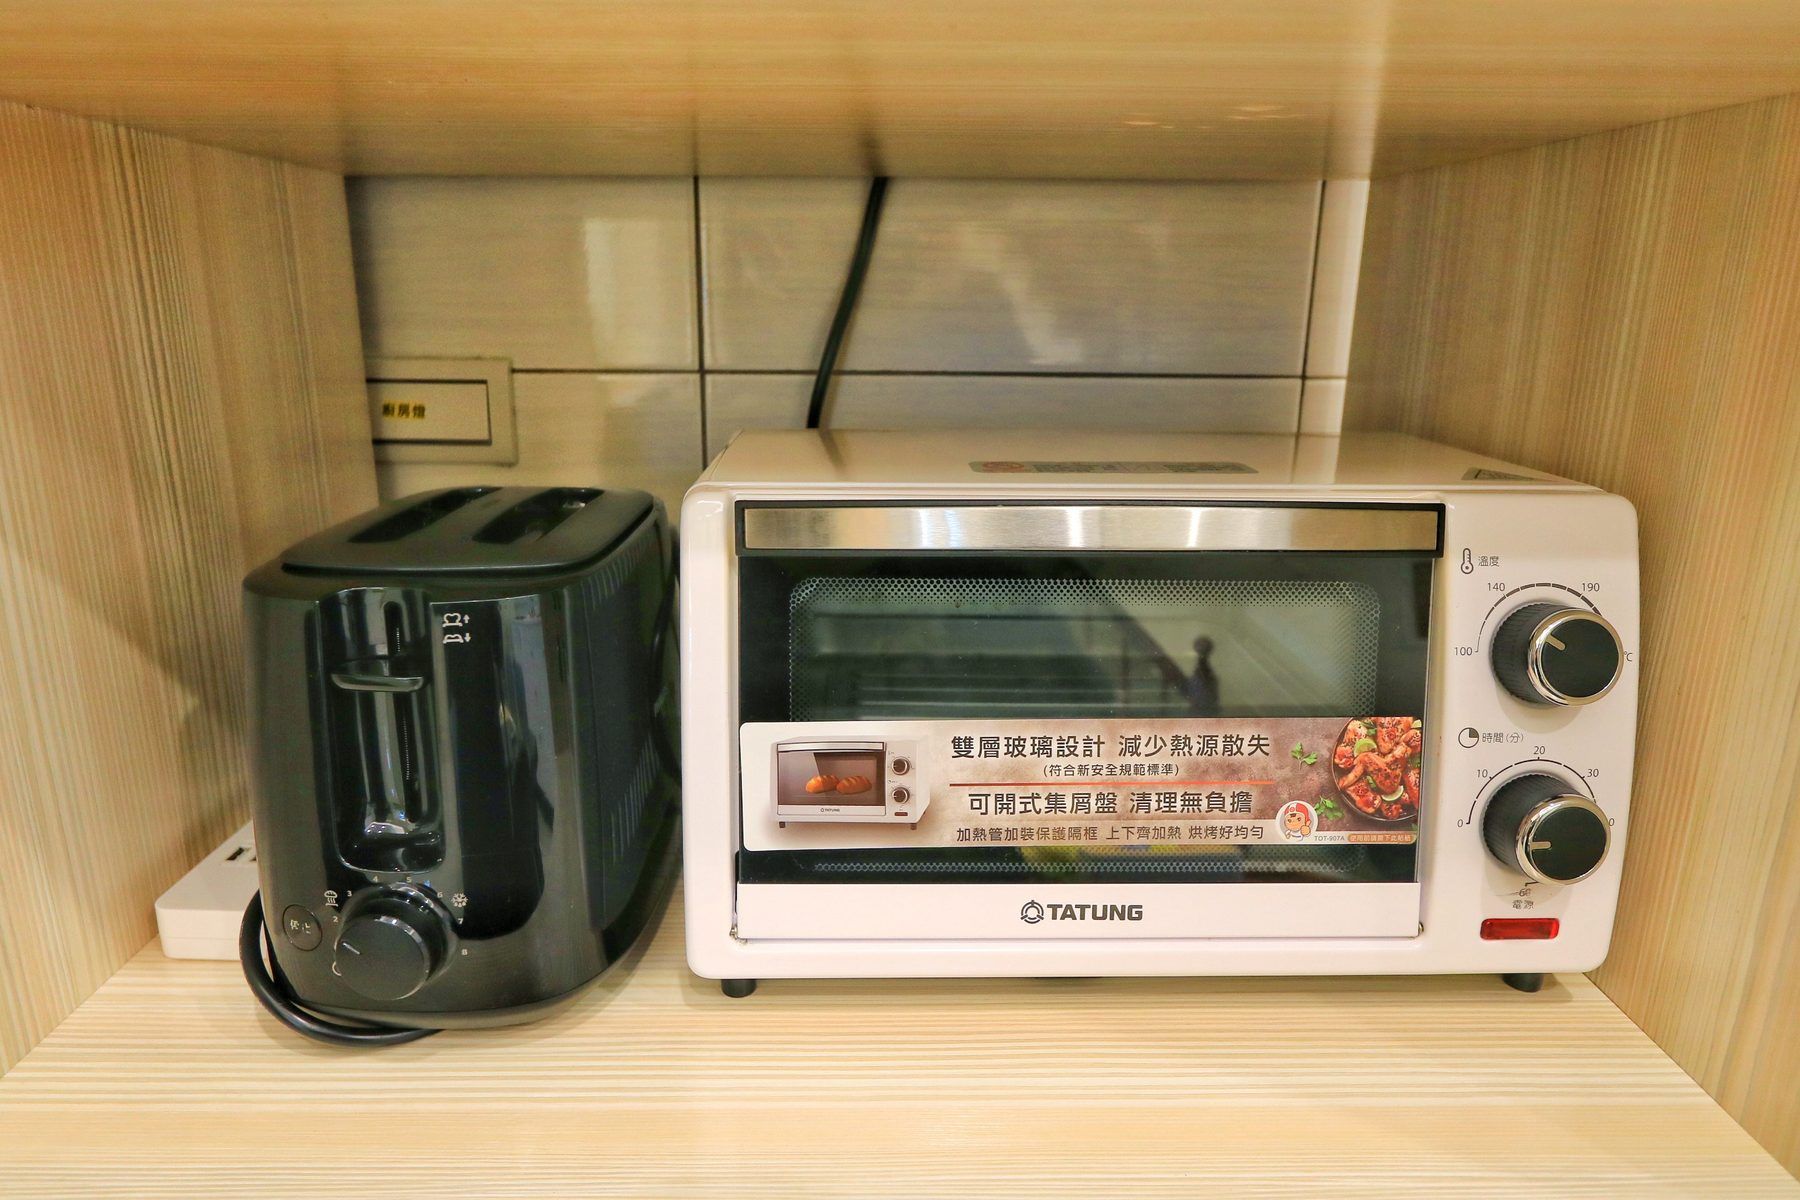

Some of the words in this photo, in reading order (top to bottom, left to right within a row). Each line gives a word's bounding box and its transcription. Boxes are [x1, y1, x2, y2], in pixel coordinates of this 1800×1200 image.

[1478, 555, 1500, 567] 溫度
[1487, 582, 1506, 591] 140
[1582, 582, 1600, 592] 190
[1454, 646, 1473, 656] 100
[951, 735, 1106, 759] 雙層玻璃設計
[1118, 734, 1270, 757] 減少熱源散失
[1533, 745, 1546, 755] 20
[1043, 763, 1180, 778] (符合新安全規範標準)
[1476, 769, 1488, 778] 10
[1587, 768, 1600, 778] 30
[968, 792, 1118, 815] 可開式集屑盤
[1129, 791, 1253, 814] 清理無負擔
[1457, 819, 1464, 828] 0
[956, 826, 1099, 842] 加熱管加裝保護隔框
[1106, 826, 1182, 841] 上下齊加熱
[1188, 825, 1264, 840] 烘烤好均勻
[1046, 904, 1143, 921] TATUNG
[332, 915, 339, 923] 2
[457, 917, 464, 925] 7
